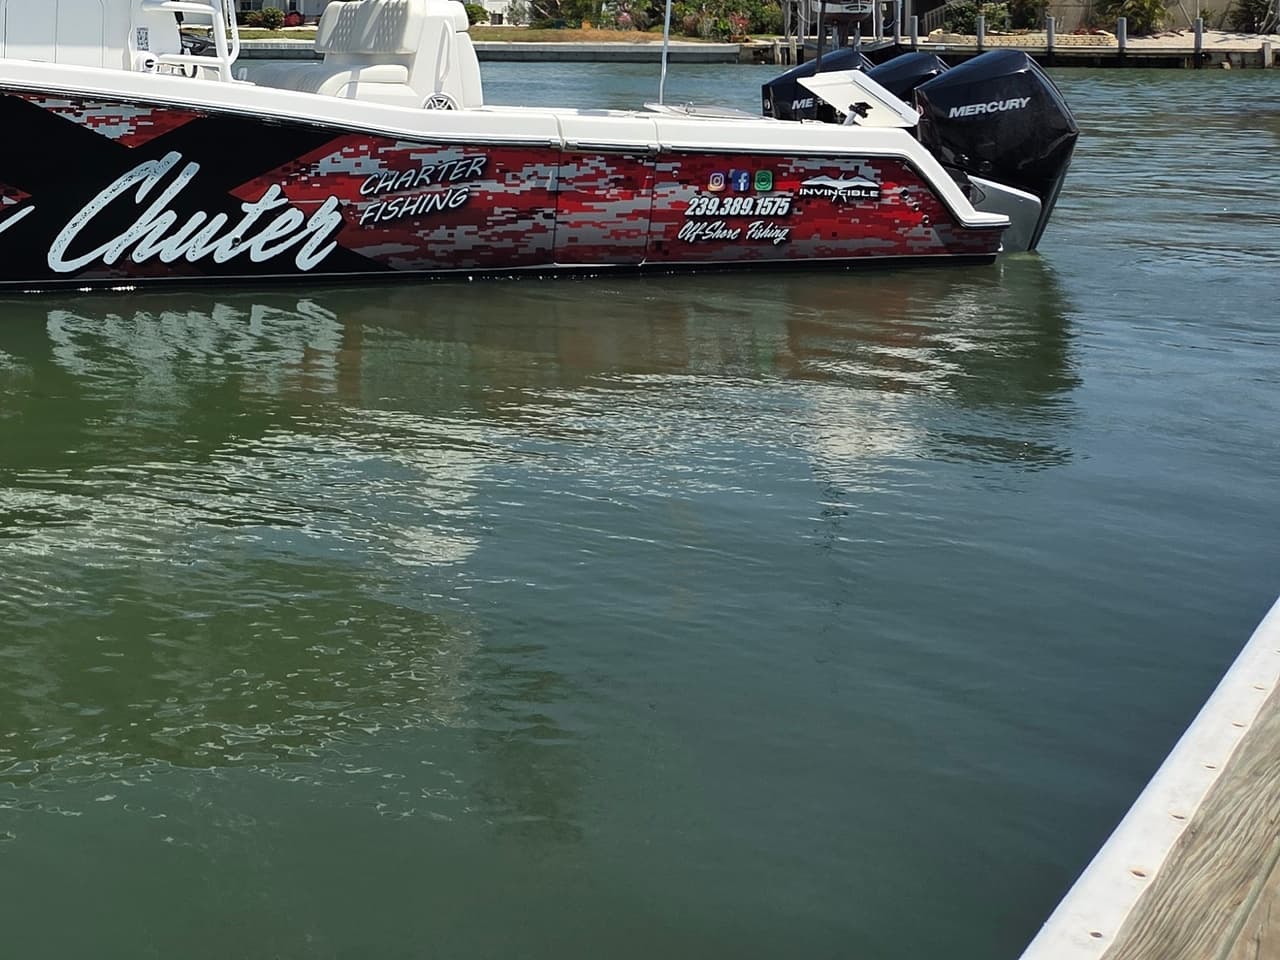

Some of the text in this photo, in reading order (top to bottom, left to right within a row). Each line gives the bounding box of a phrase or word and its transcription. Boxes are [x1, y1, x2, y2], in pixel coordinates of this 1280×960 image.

[948, 97, 1031, 119] MERCURY
[359, 157, 487, 195] CHARTER
[799, 188, 880, 198] INVINCIBLE
[47, 150, 343, 273] Chuter
[359, 187, 469, 225] FISHING
[684, 197, 792, 216] 239.389.1575
[677, 220, 790, 245] Off-Shore Fishing
